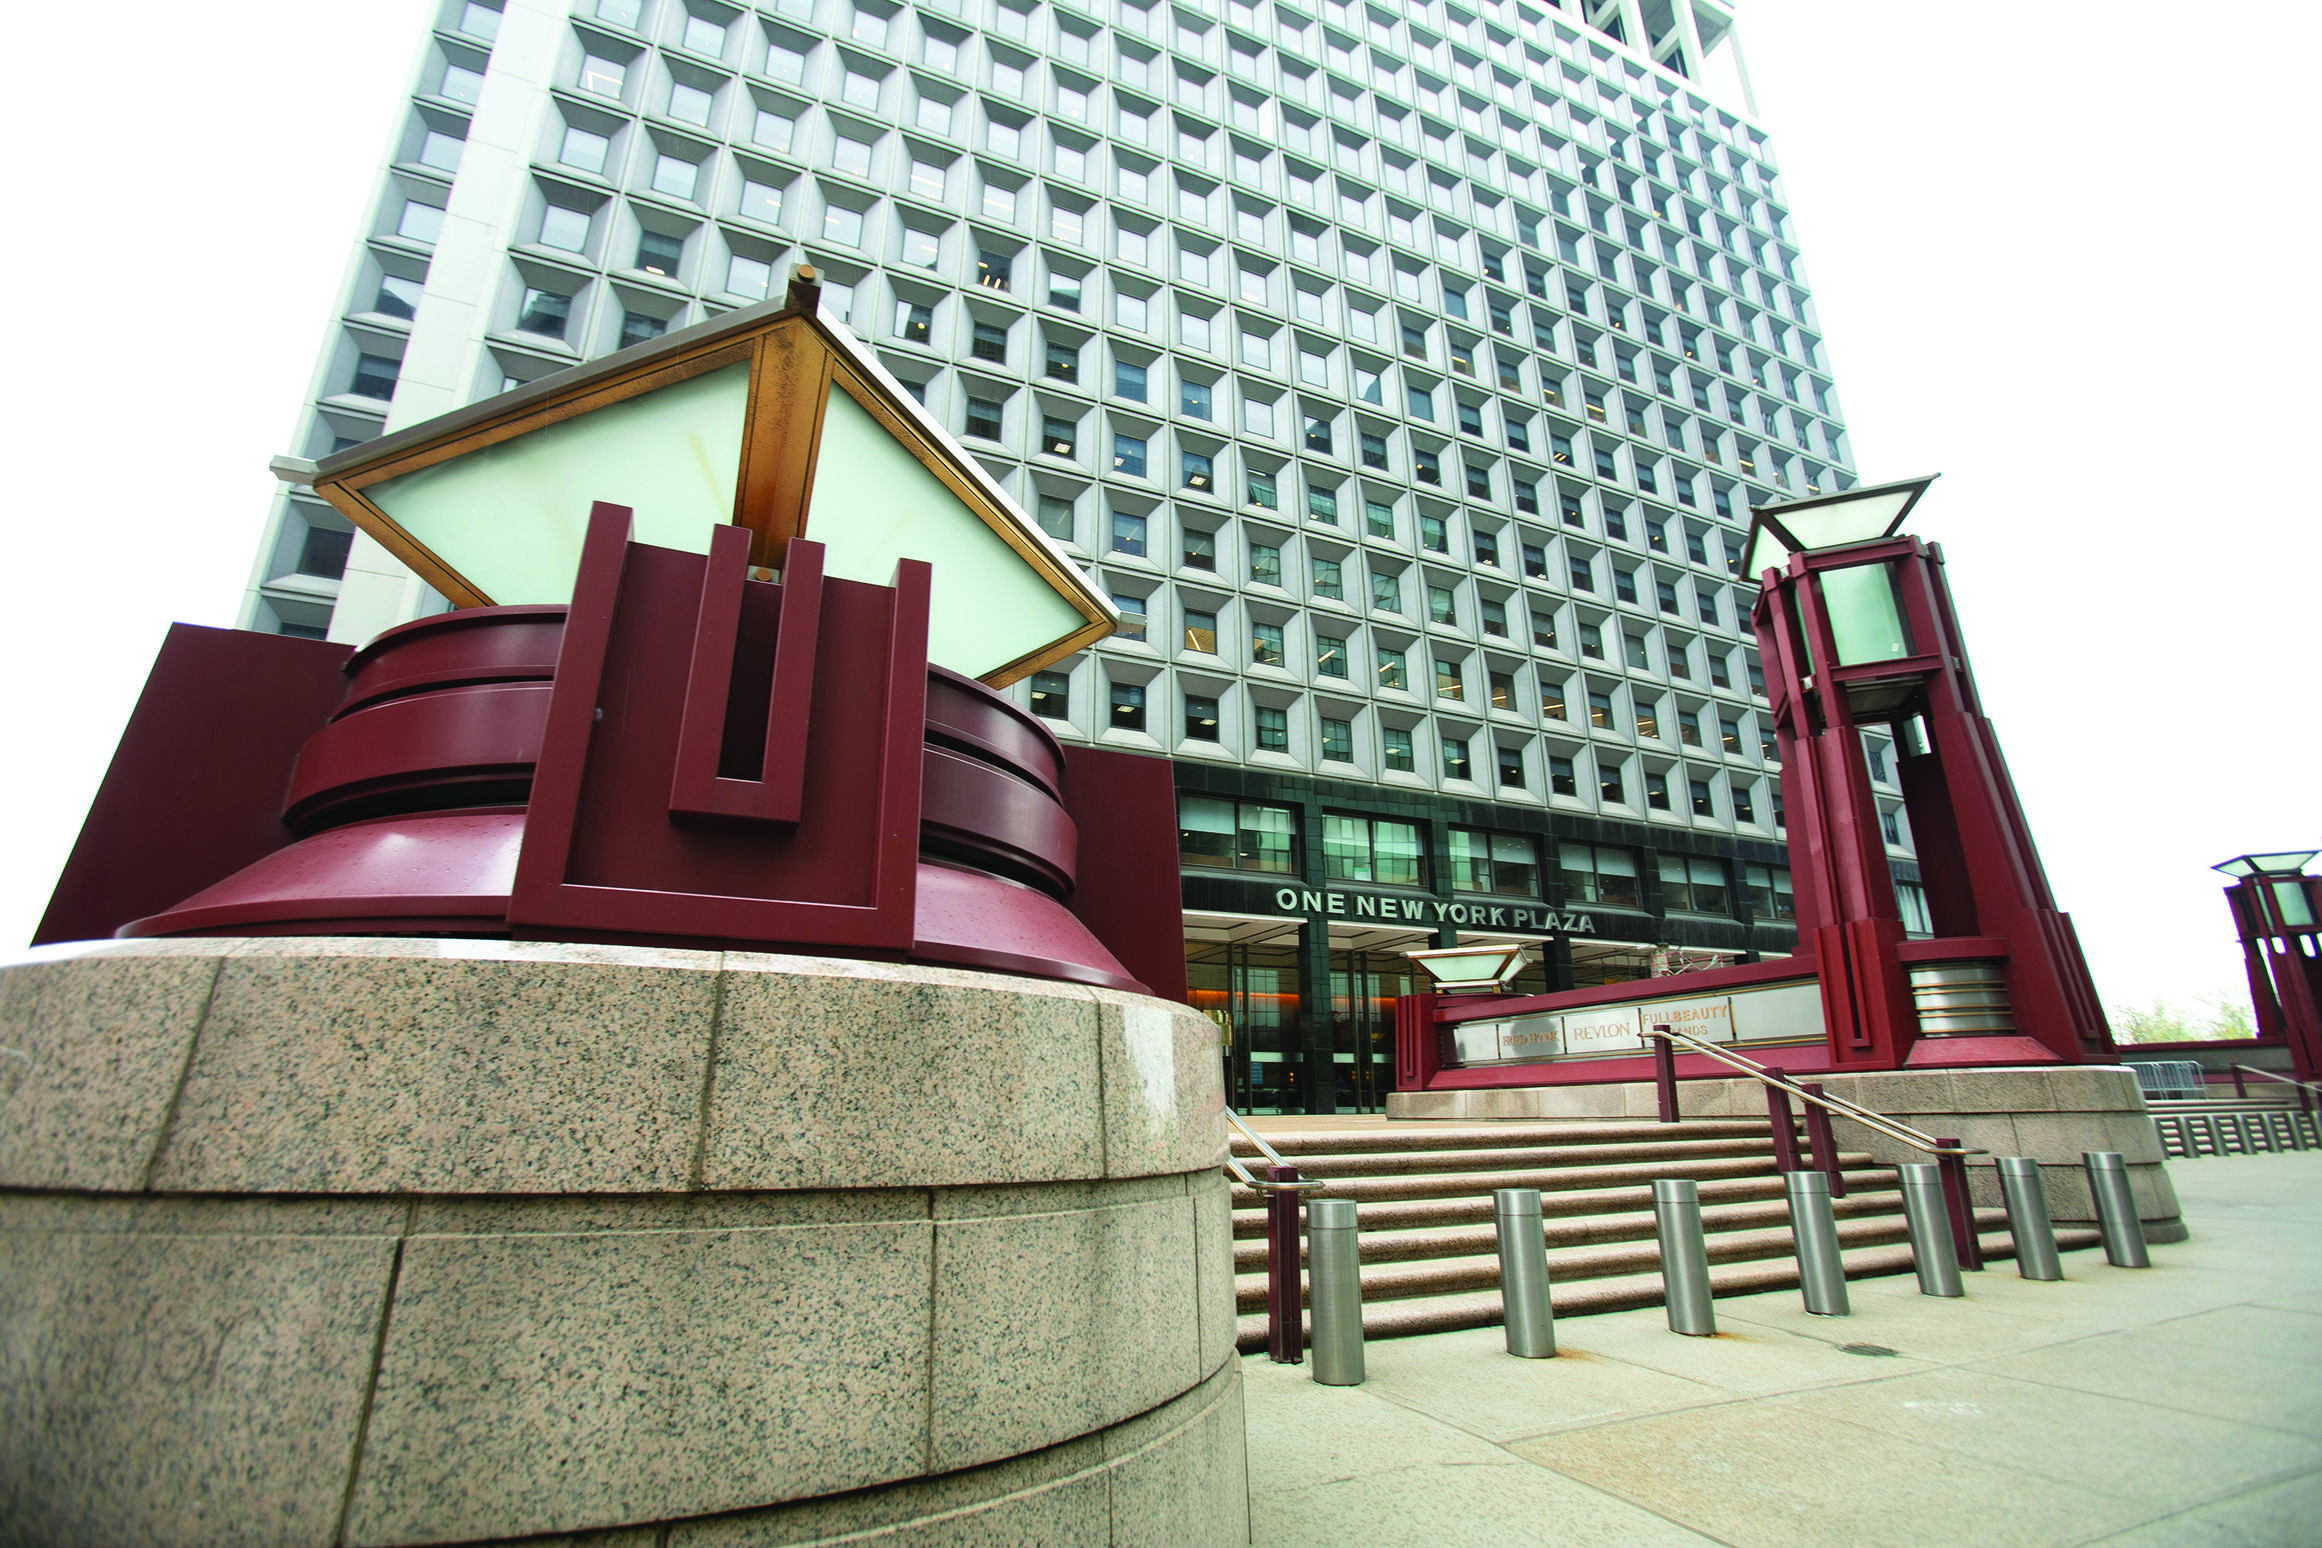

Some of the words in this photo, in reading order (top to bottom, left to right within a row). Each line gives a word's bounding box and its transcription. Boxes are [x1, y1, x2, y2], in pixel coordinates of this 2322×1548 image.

[1275, 888, 1346, 915] ONE
[1356, 895, 1425, 920] NEW
[1432, 902, 1508, 926] YORK
[1514, 908, 1597, 933] PLAZA
[1642, 1005, 1727, 1024] FULLBEAUTY
[1573, 1022, 1631, 1041] REVLON
